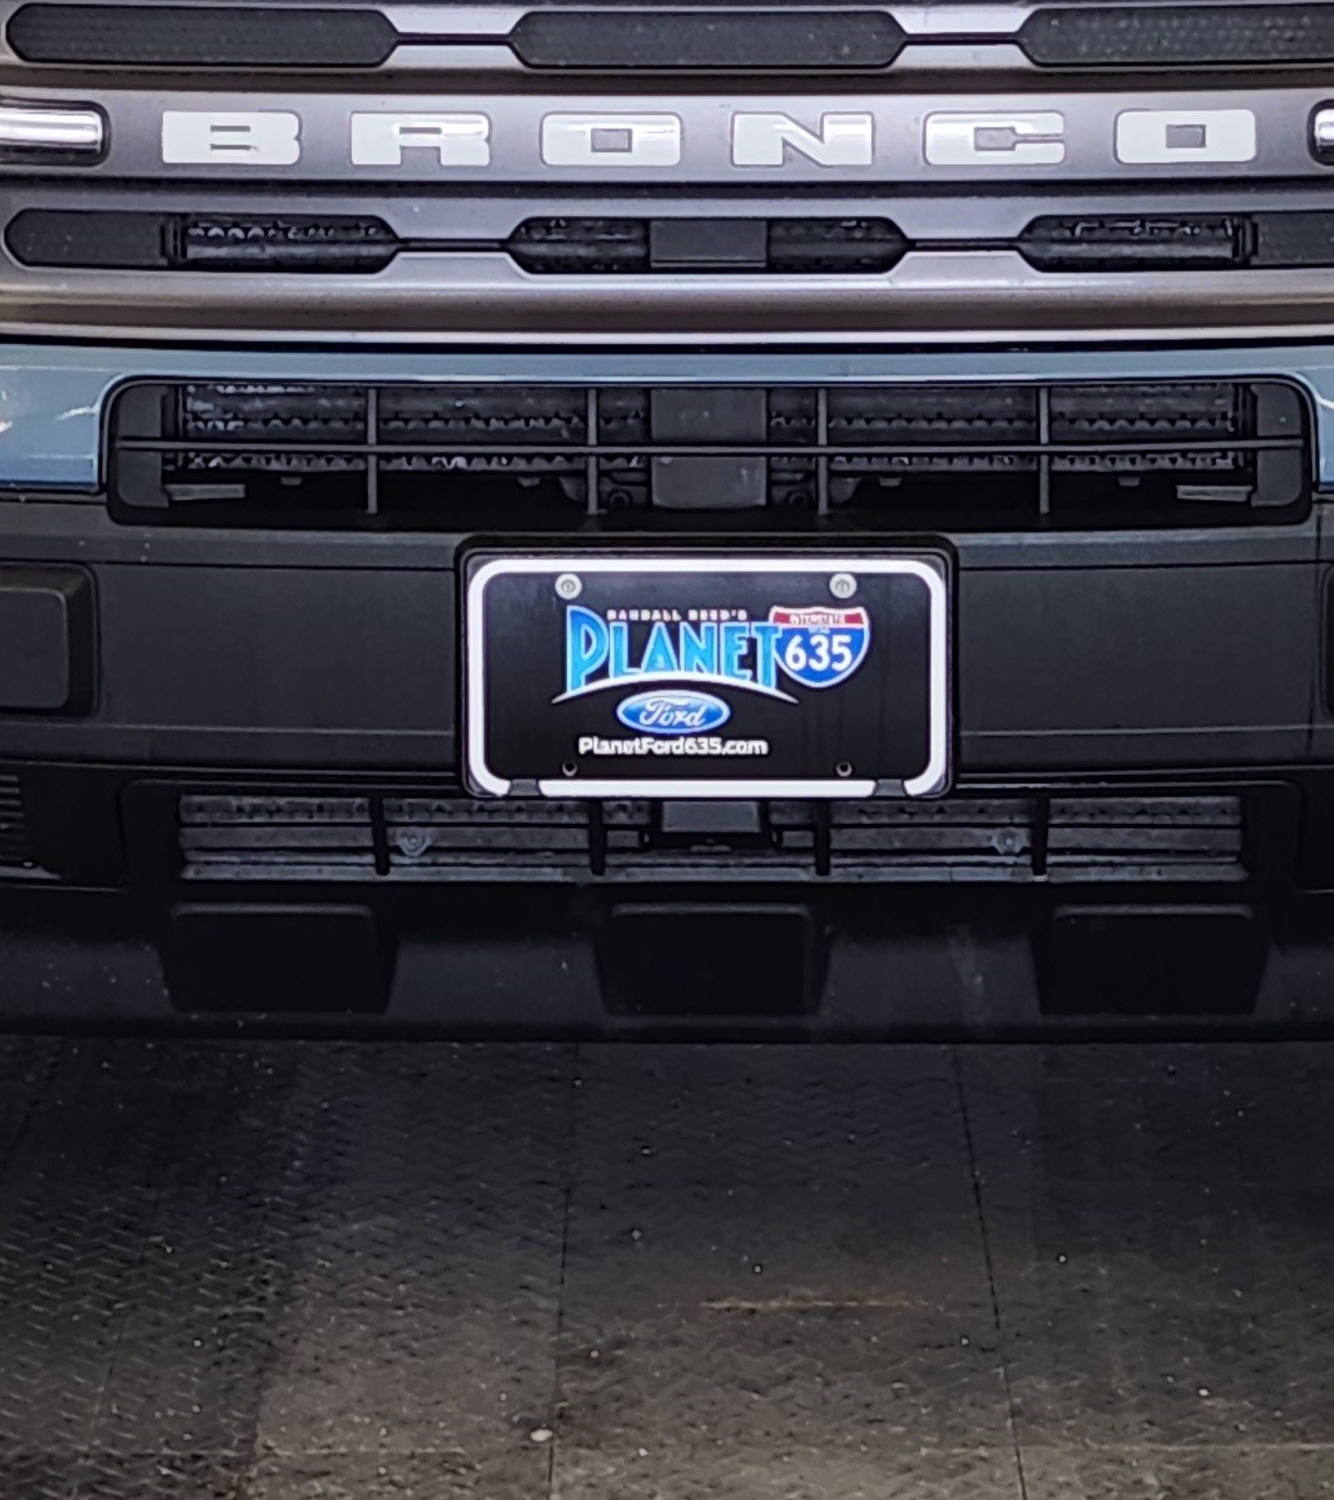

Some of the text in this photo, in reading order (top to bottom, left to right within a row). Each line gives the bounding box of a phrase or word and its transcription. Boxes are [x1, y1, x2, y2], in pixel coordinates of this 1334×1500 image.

[160, 108, 1260, 169] BRONCO
[566, 604, 783, 694] PLANET
[784, 634, 854, 672] 635
[638, 699, 708, 727] Ford
[578, 736, 769, 756] PlanetFord635.com
